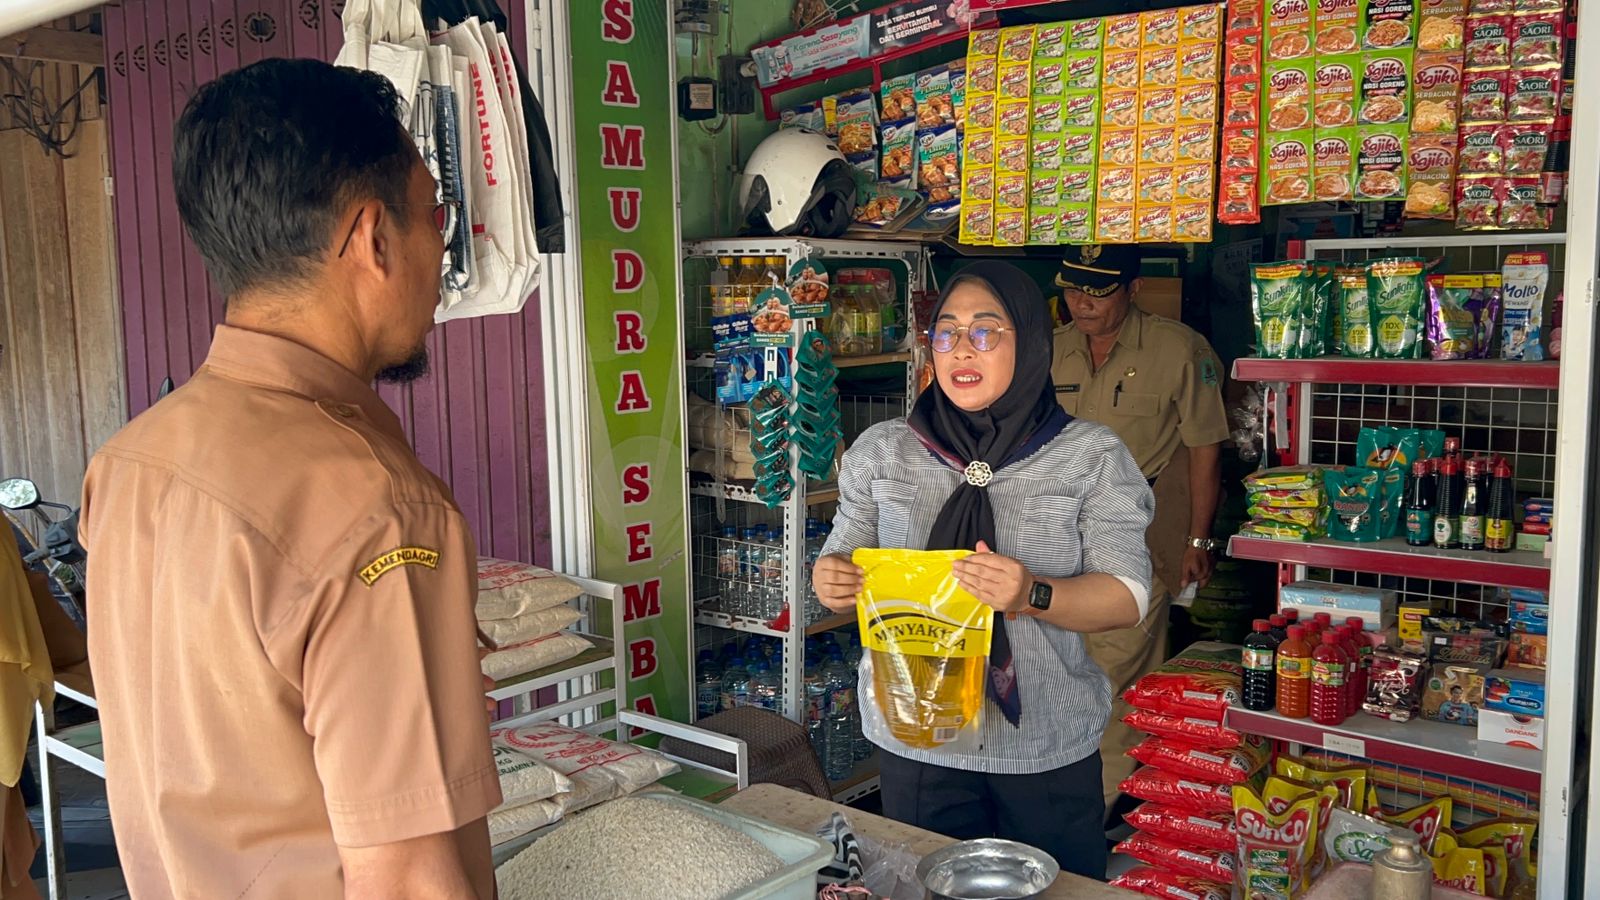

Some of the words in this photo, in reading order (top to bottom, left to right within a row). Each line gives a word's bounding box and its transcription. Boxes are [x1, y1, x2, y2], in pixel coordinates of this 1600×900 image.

[1184, 7, 1215, 24] Masako
[1271, 0, 1309, 19] Sajiku
[1368, 7, 1384, 15] NASI
[1385, 4, 1412, 13] GORENG
[887, 15, 931, 34] BERVITAMIN
[895, 19, 943, 39] BERMINERAL
[1071, 18, 1100, 33] Masako
[1108, 19, 1137, 33] Masako
[1145, 14, 1176, 30] Masako
[1037, 25, 1064, 39] Masako
[1474, 28, 1502, 38] SAORI
[1522, 25, 1551, 36] SAORI
[1068, 56, 1096, 71] Masako
[1144, 54, 1175, 69] Masako
[1182, 48, 1212, 64] Masako
[1036, 63, 1062, 77] Masako
[1106, 58, 1135, 72] Masako
[1366, 63, 1405, 82] Sajiku
[1270, 73, 1307, 91] Sajiku
[1315, 69, 1353, 87] Sajiku
[1380, 80, 1405, 88] GORENG
[1414, 68, 1461, 90] Sajiku
[1470, 83, 1498, 92] SAORI
[1519, 81, 1549, 91] SAORI
[1067, 94, 1094, 109] Masako
[1104, 96, 1134, 110] Masako
[1143, 93, 1173, 108] Masako
[1181, 88, 1211, 103] Masako
[1034, 101, 1060, 115] Masako
[469, 62, 498, 187] FORTUNE
[1065, 133, 1092, 147] Masako
[1103, 135, 1132, 148] Masako
[1142, 133, 1172, 148] Masako
[1179, 128, 1209, 143] Masako
[1467, 136, 1493, 146] SAORI
[1515, 136, 1544, 145] SAORI
[1033, 139, 1060, 152] Masako
[1270, 144, 1307, 162] Sajiku
[1314, 142, 1348, 160] Sajiku
[1361, 138, 1401, 157] Sajiku
[1376, 155, 1402, 163] GORENG
[1408, 152, 1454, 172] Sajiku
[1032, 176, 1058, 189] Masako
[1063, 171, 1090, 184] Masako
[1101, 173, 1131, 186] Masako
[1140, 173, 1170, 186] Masako
[1177, 168, 1208, 183] Masako
[1466, 189, 1491, 198] SAORI
[600, 0, 652, 413] SAMUDRA
[1031, 212, 1057, 226] Masako
[1060, 208, 1088, 222] Masako
[1099, 211, 1129, 225] Masako
[1139, 209, 1169, 225] Masako
[1176, 207, 1206, 222] Masako
[1378, 279, 1416, 305] Sunlight
[1503, 283, 1539, 299] Molto
[1385, 322, 1400, 330] 10X
[362, 550, 437, 581] KEMENDAGRI
[1505, 728, 1538, 738] DANDANG
